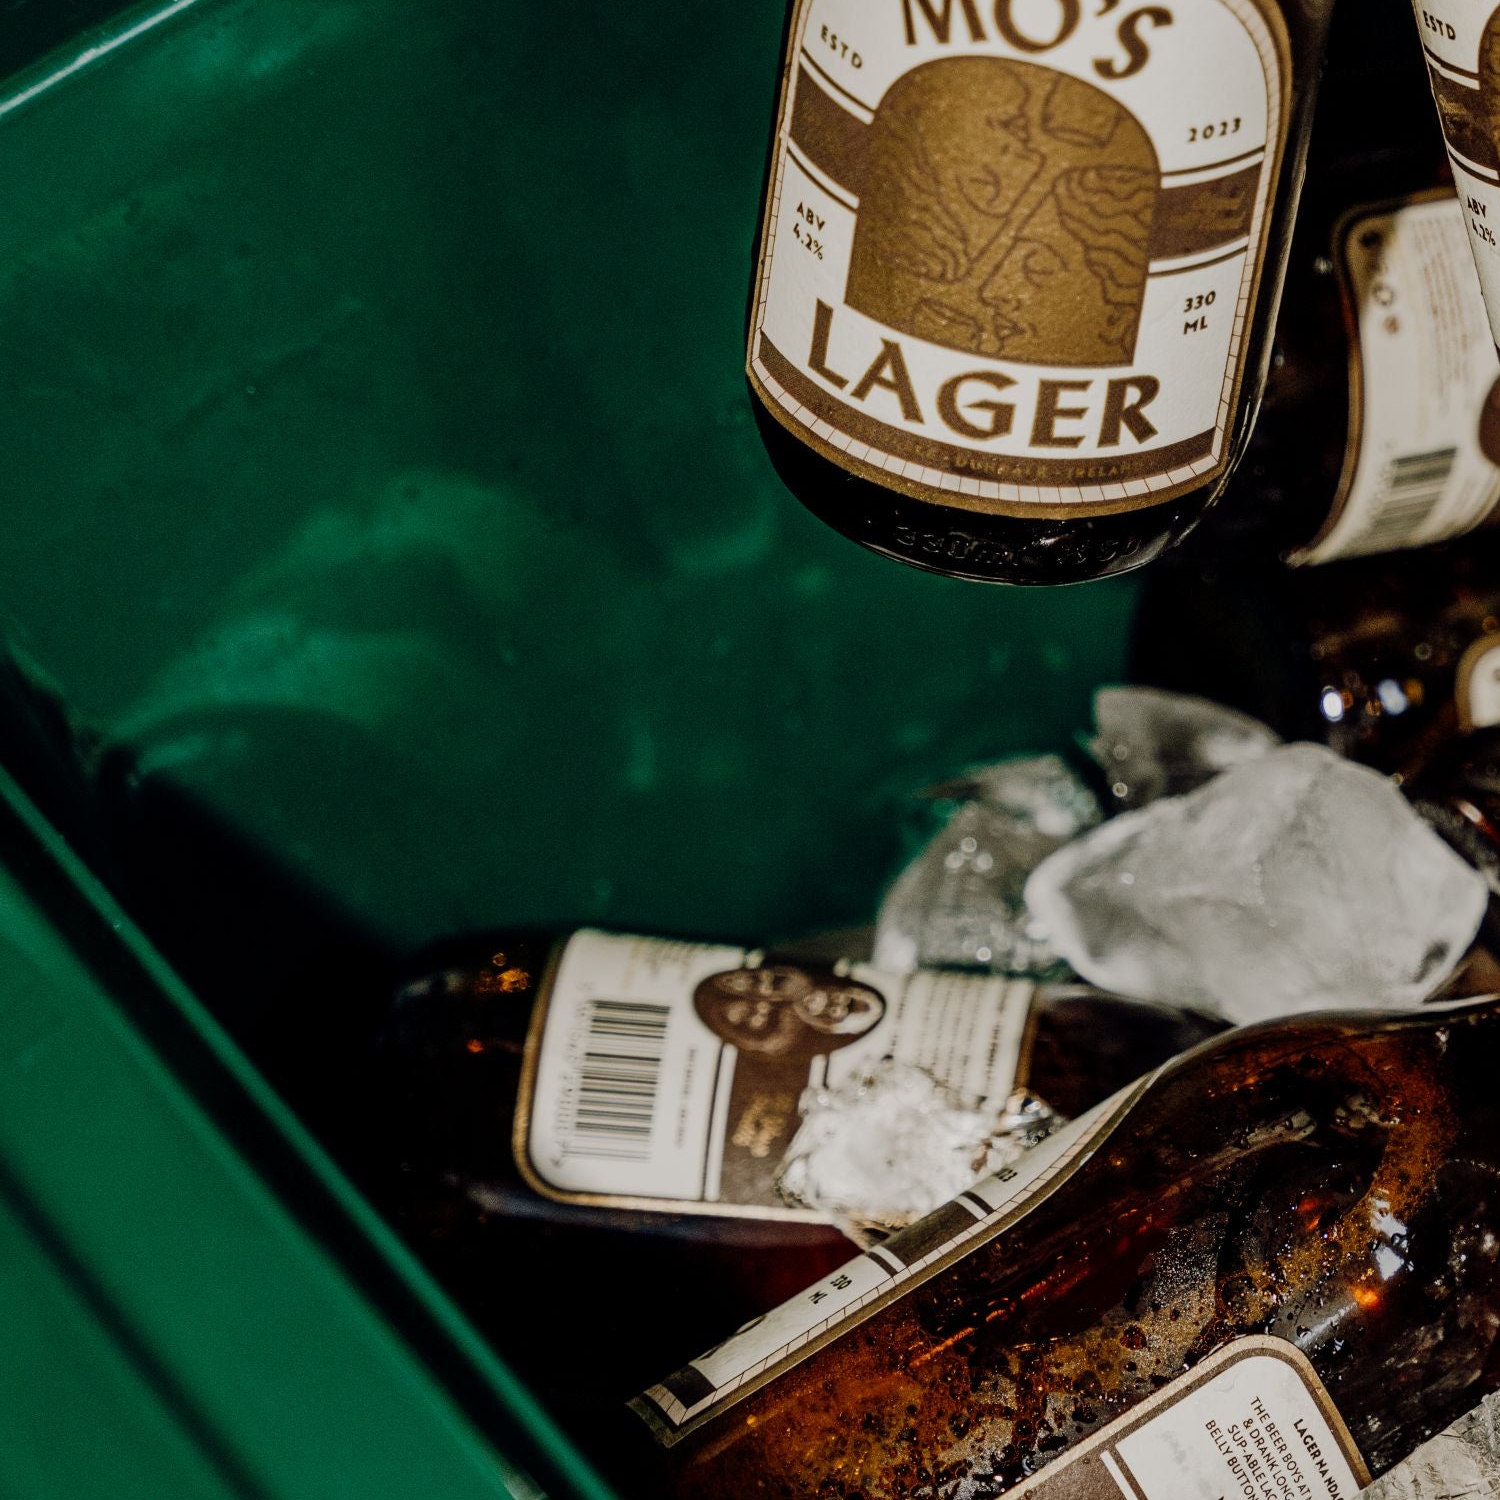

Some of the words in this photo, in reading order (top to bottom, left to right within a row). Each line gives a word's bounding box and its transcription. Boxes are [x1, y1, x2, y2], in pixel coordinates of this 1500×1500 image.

[1422, 10, 1457, 41] ESTD
[820, 25, 863, 69] ESTD
[1187, 117, 1242, 143] 2023
[796, 202, 825, 232] ABV
[1467, 195, 1487, 219] ABV
[793, 223, 824, 261] 4.2%
[1472, 222, 1497, 247] 4.2%
[1183, 290, 1217, 313] 330
[1183, 315, 1208, 335] ML
[806, 297, 1162, 450] LAGER
[1204, 1419, 1232, 1457] BELLY
[1226, 1423, 1266, 1482] SUP-ABLE
[1242, 1417, 1254, 1429] &
[1248, 1428, 1278, 1471] DRANK
[1249, 1396, 1270, 1423] THE
[1264, 1422, 1288, 1453] BEER
[1281, 1453, 1304, 1484] BOYS
[1296, 1482, 1310, 1497] AT
[1292, 1418, 1322, 1460] LAGER
[1314, 1458, 1331, 1478] NA
